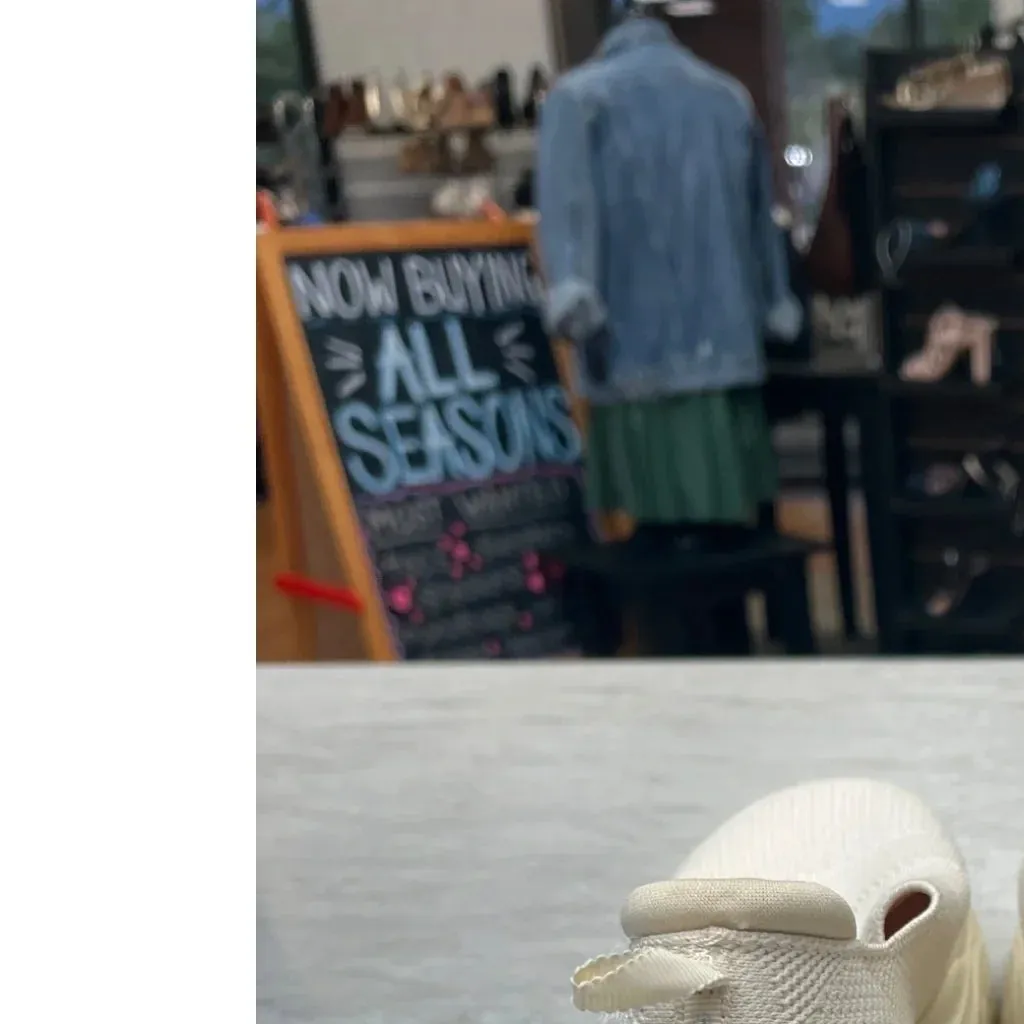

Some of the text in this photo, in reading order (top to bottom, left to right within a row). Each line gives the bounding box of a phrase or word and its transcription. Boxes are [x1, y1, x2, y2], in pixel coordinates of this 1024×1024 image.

[289, 257, 398, 320] NOW
[378, 316, 499, 401] ALL
[335, 388, 583, 495] SEASONS
